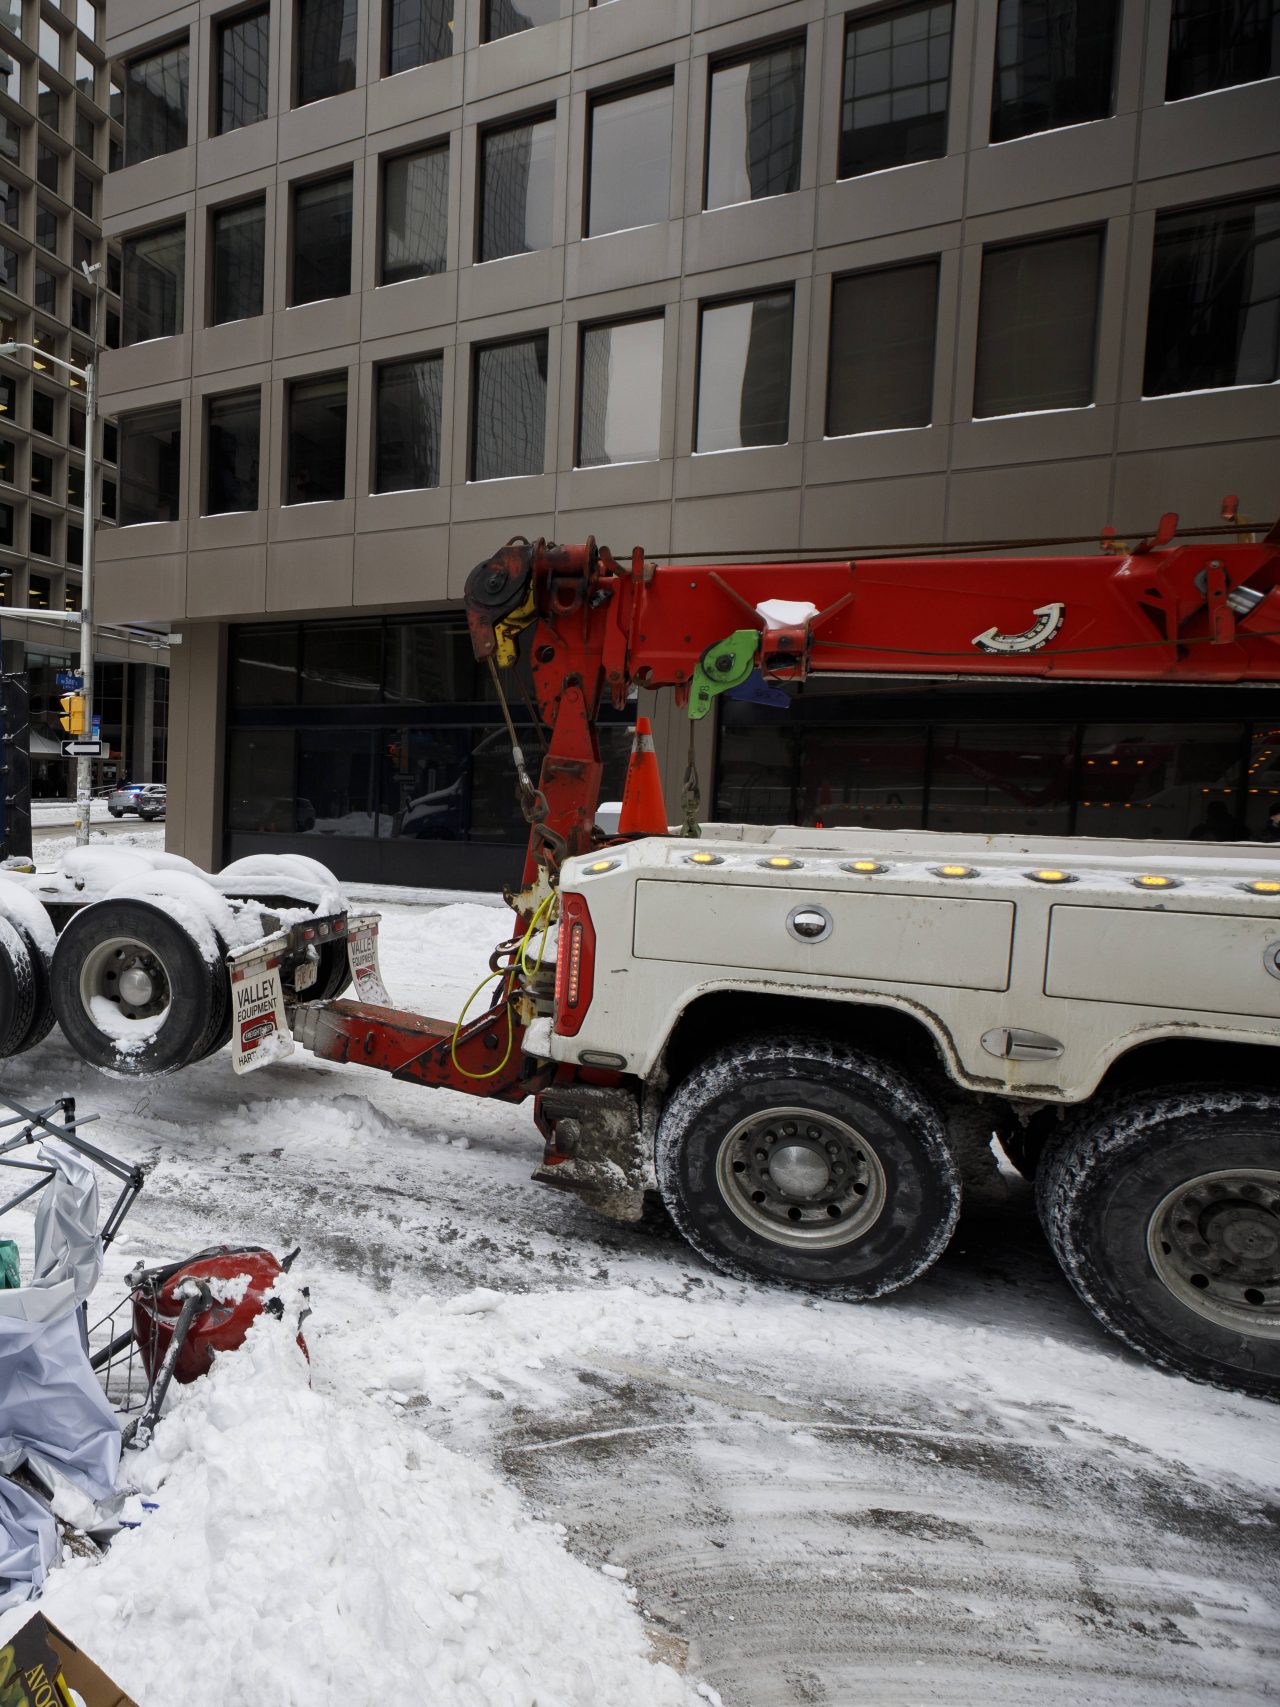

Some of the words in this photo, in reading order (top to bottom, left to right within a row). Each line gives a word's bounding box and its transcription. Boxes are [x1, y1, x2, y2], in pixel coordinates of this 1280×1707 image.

[351, 937, 375, 956] VALLEY
[352, 951, 376, 967] EQUIPMENT
[237, 977, 275, 1009] VALLEY
[238, 998, 277, 1022] EQUIPMENT
